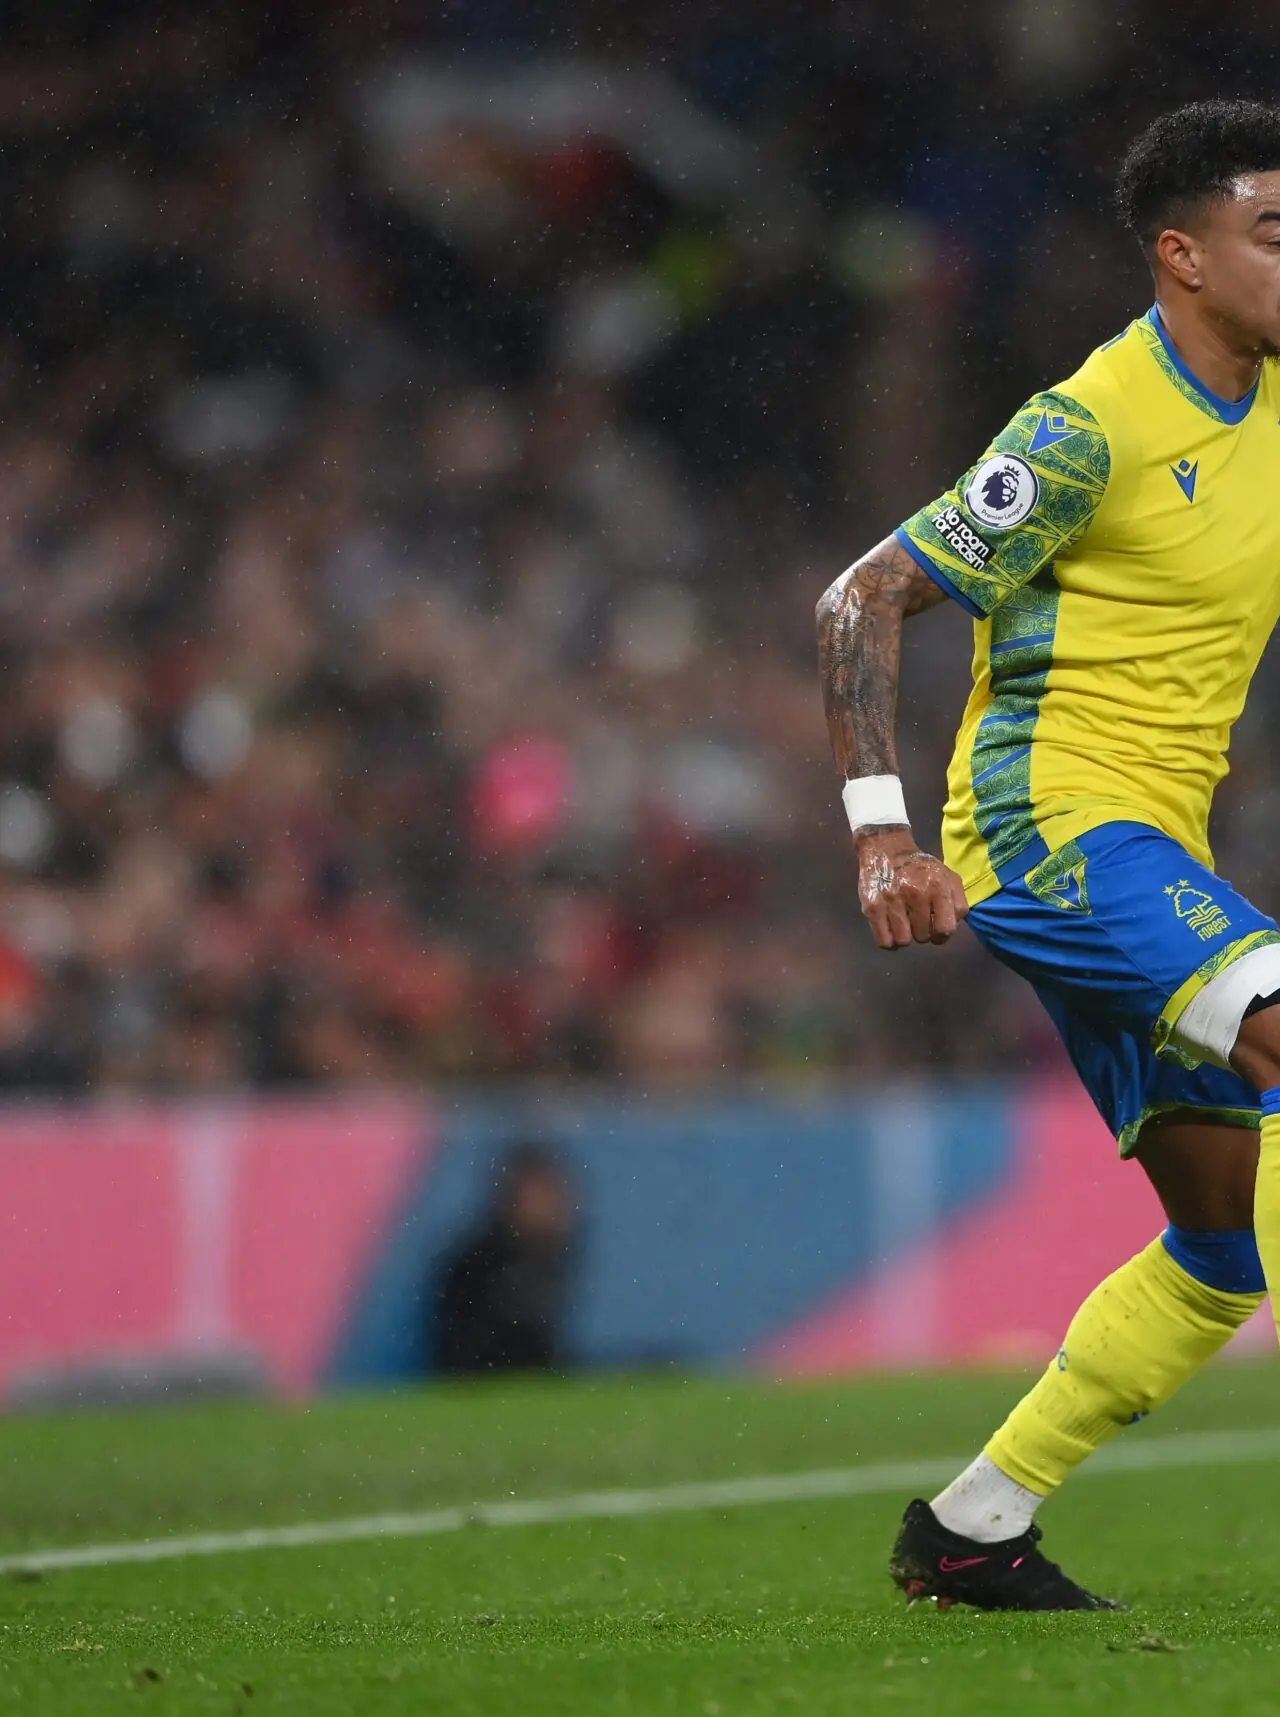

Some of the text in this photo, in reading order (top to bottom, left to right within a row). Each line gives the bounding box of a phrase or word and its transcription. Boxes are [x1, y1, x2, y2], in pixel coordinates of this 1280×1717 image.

[940, 505, 990, 558] No room
[981, 503, 1024, 520] Premier League
[931, 514, 985, 571] for racism
